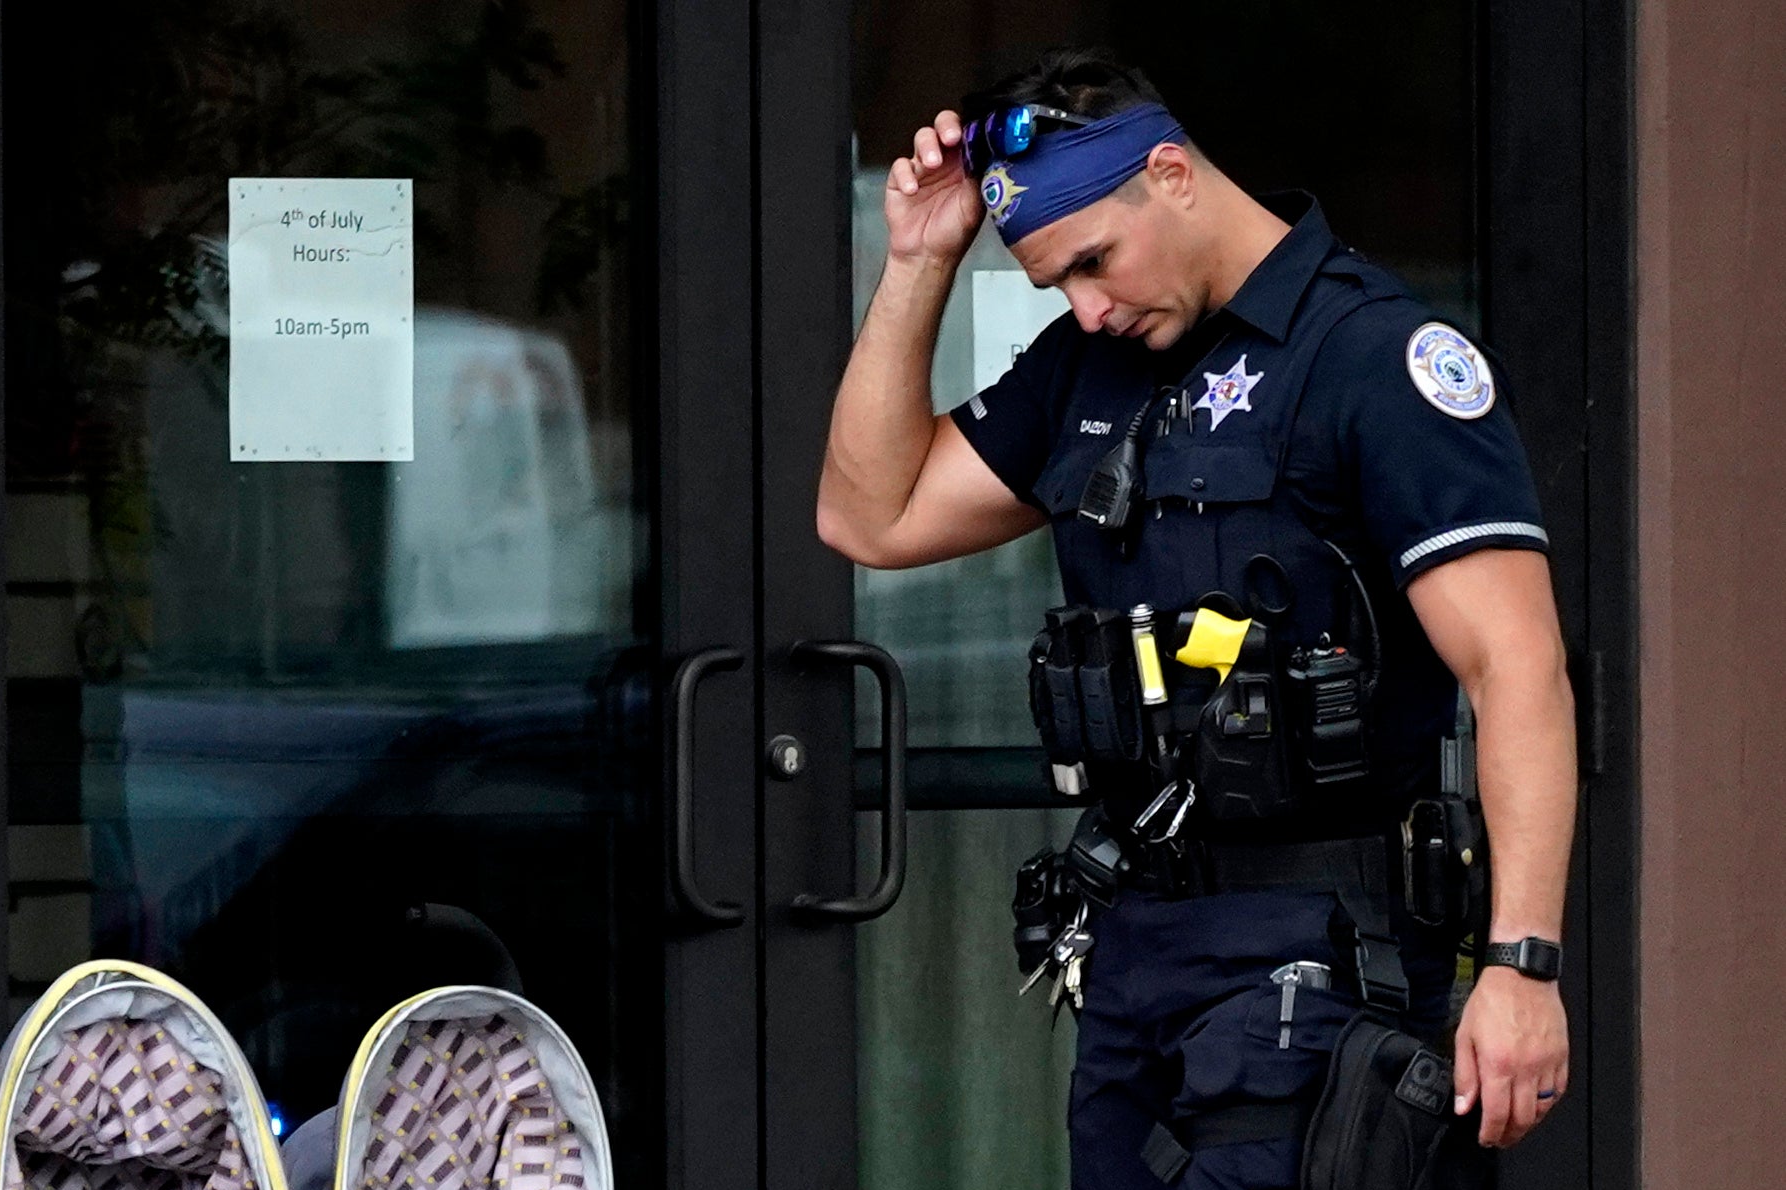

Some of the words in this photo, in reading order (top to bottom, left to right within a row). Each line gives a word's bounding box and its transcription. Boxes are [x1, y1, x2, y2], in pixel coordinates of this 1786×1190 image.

[280, 208, 304, 229] 4th
[308, 210, 327, 229] of
[330, 210, 364, 233] July
[293, 244, 351, 263] Hours:
[274, 317, 370, 340] 10am-5pm
